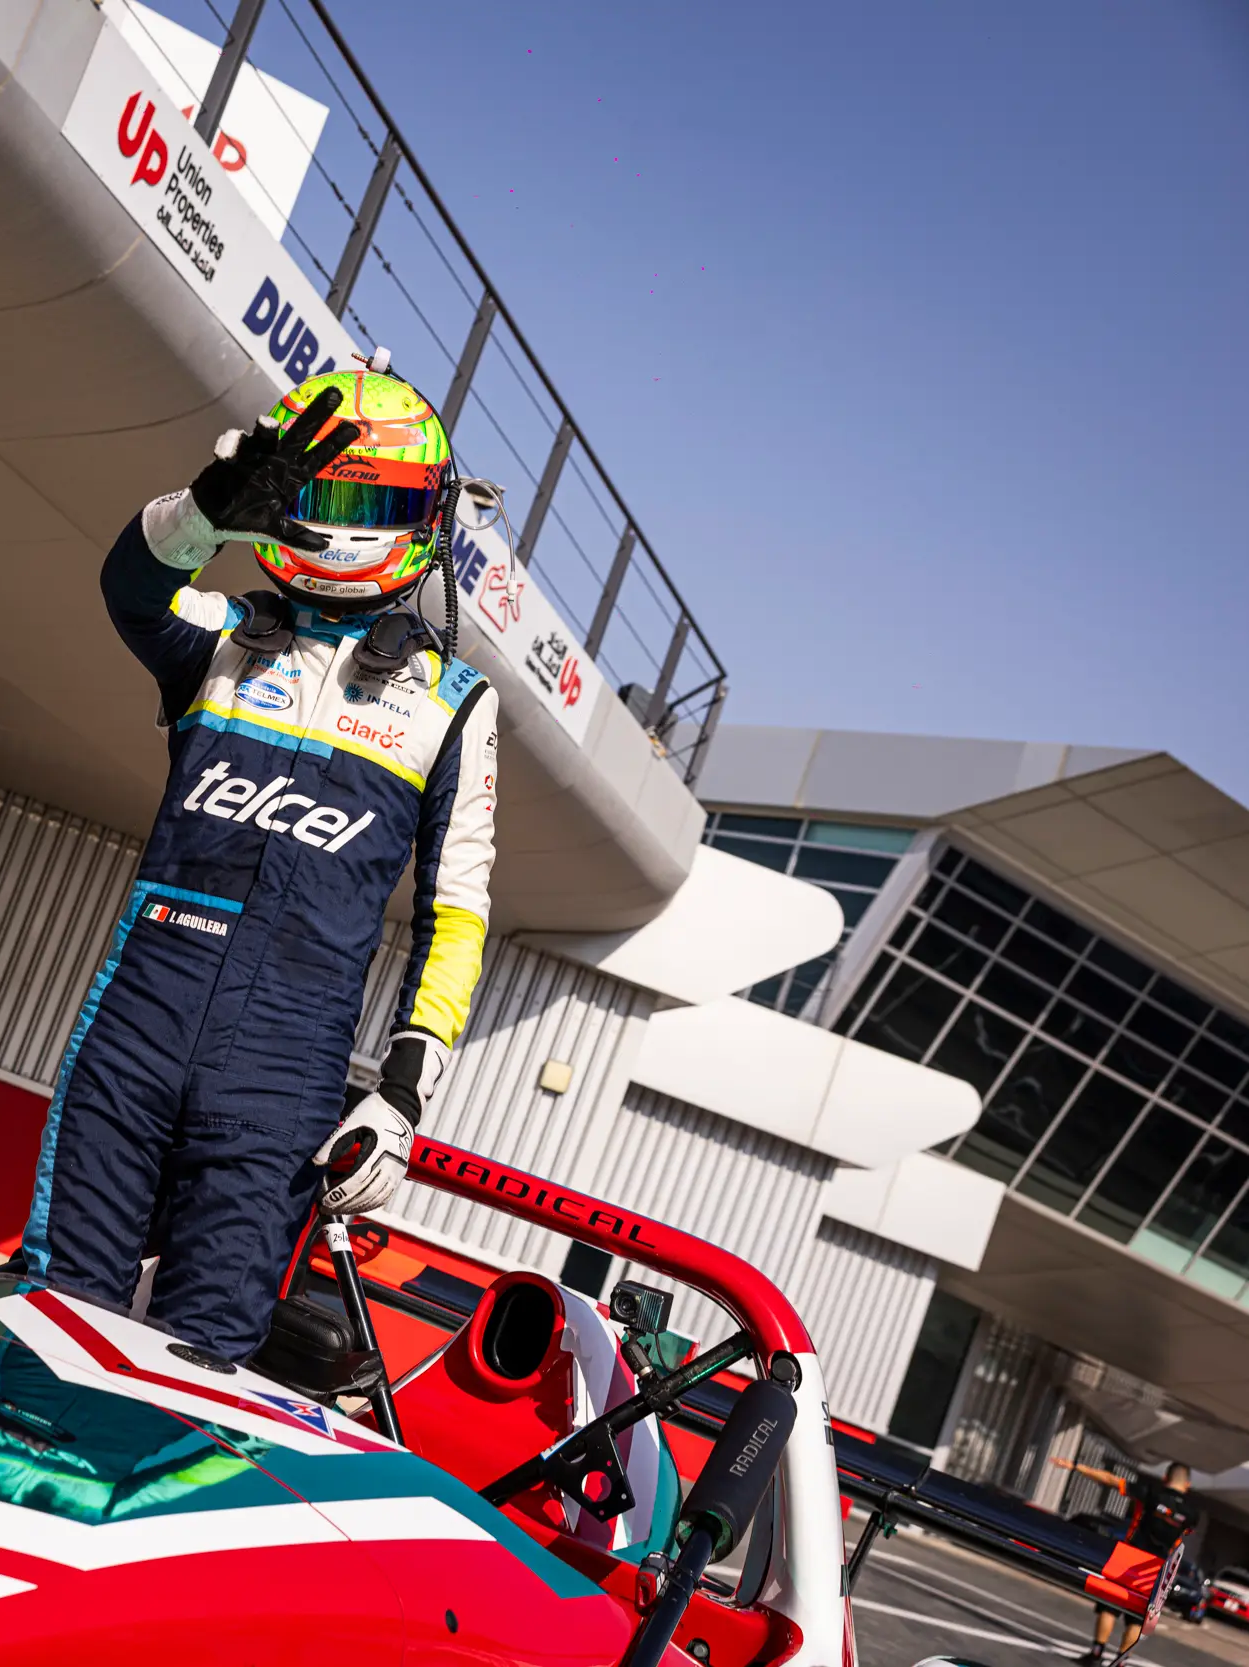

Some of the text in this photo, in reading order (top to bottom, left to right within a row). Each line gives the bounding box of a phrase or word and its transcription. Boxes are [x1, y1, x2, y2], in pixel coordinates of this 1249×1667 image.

[117, 90, 168, 187] UP
[177, 145, 212, 206] Union
[165, 172, 224, 261] Properties
[336, 469, 380, 481] RAW
[339, 586, 366, 595] global
[252, 688, 287, 704] TELMEX
[366, 694, 411, 718] INTELA
[336, 715, 394, 749] Claro
[183, 761, 376, 853] telcel
[175, 912, 228, 937] AGUILERA
[418, 1146, 656, 1250] RADICAL
[729, 1418, 779, 1478] RADICAL
